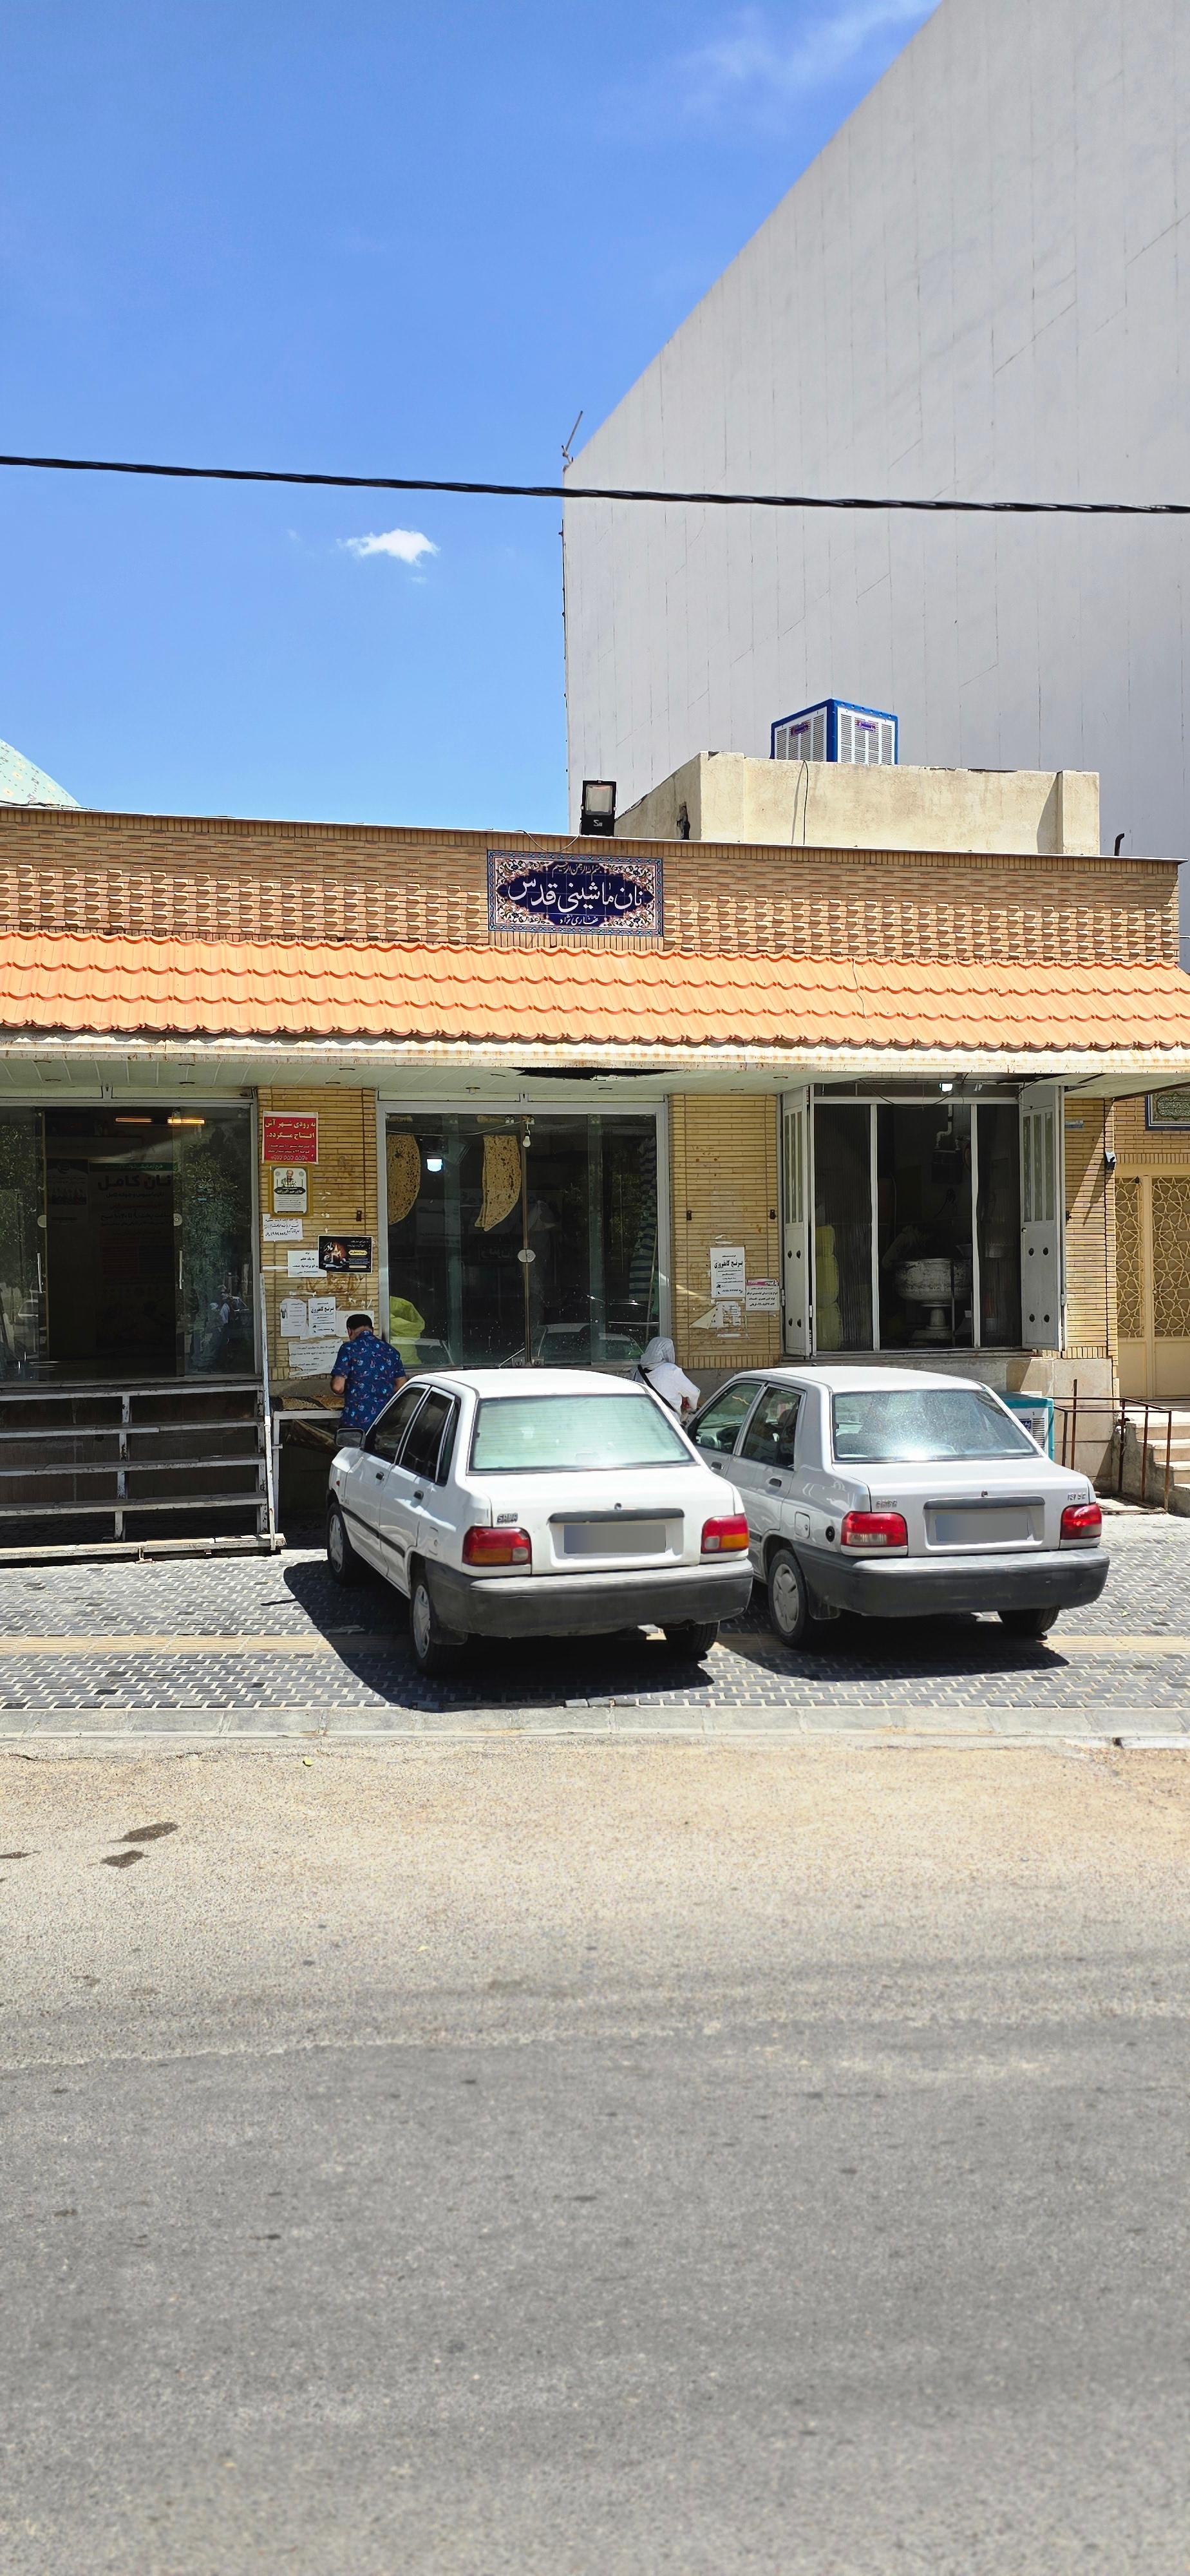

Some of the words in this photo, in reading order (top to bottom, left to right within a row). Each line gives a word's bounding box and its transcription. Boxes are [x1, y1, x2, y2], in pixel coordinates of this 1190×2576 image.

[508, 877, 558, 906] قدس
[557, 881, 614, 913] ماشینی
[614, 886, 643, 910] نان
[560, 914, 572, 925] نژاد
[571, 914, 599, 926] غفاری
